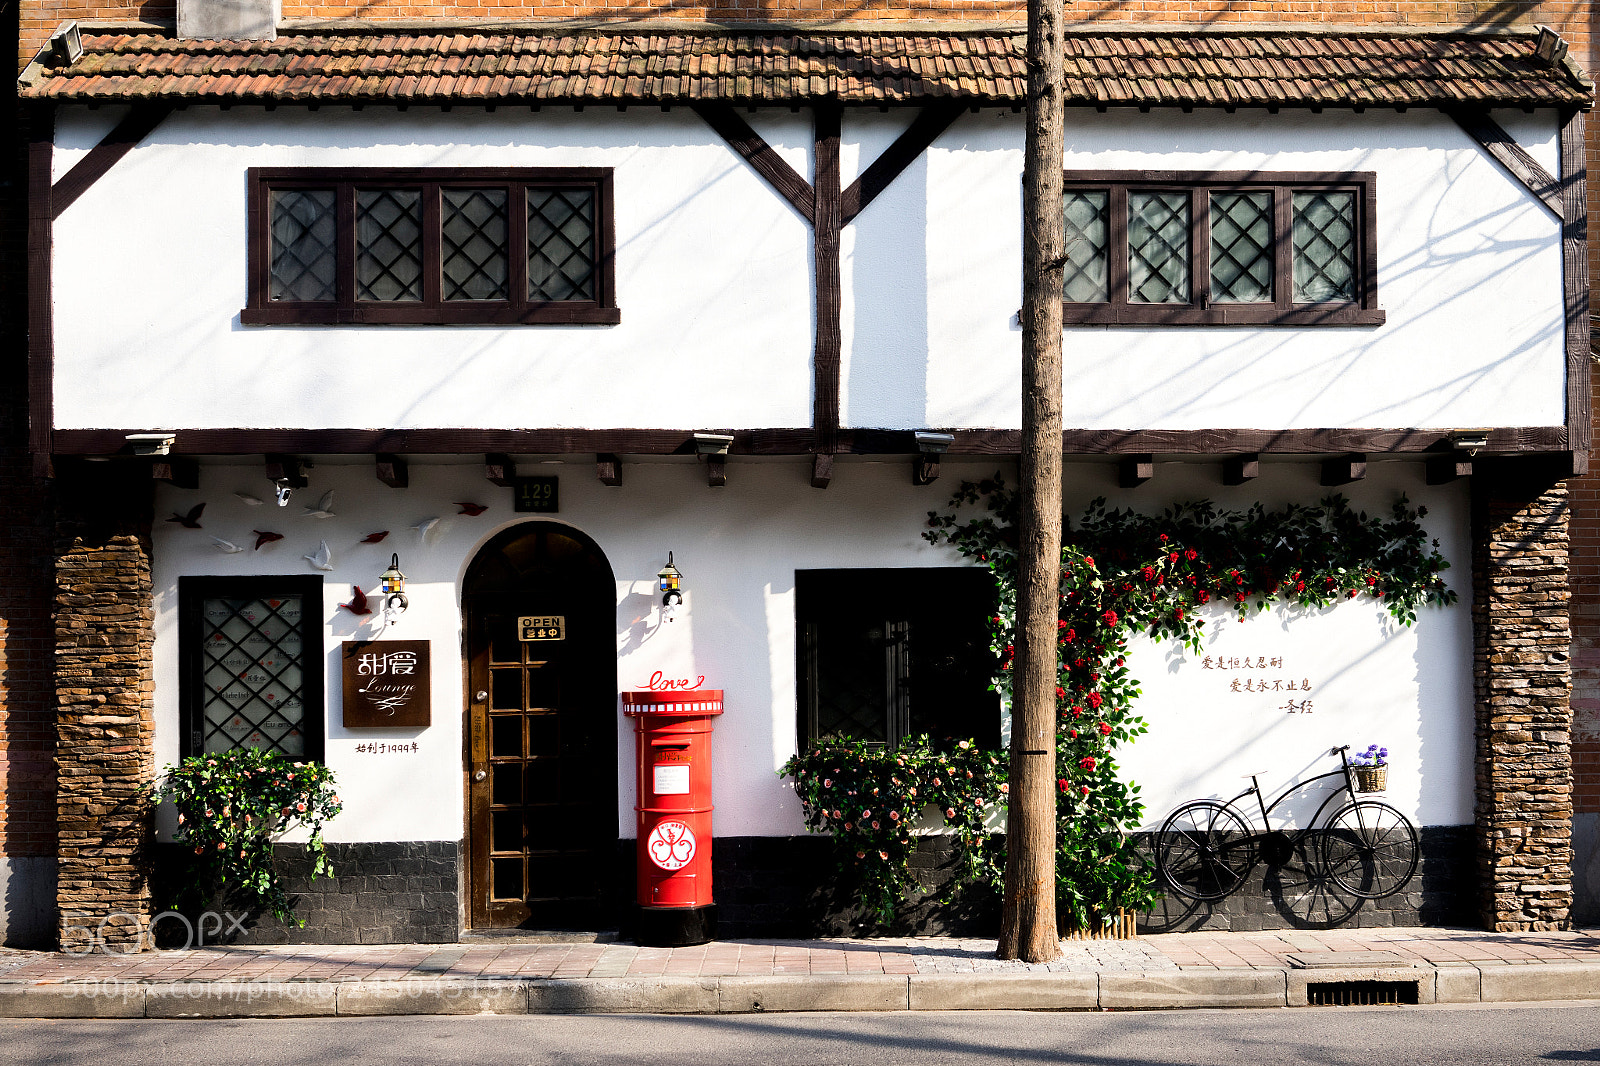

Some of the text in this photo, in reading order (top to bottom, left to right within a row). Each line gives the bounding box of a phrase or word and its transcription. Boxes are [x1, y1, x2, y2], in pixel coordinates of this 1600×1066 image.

[521, 484, 552, 499] 129
[523, 618, 560, 627] OPEN
[526, 628, 558, 638] 营业中
[357, 651, 417, 676] 甜爱
[1201, 655, 1284, 670] 爱是恒久忍耐
[358, 676, 417, 697] Lounge
[634, 670, 705, 691] love
[1229, 677, 1313, 693] 爱是永不止息
[355, 742, 419, 754] 始创于1999年
